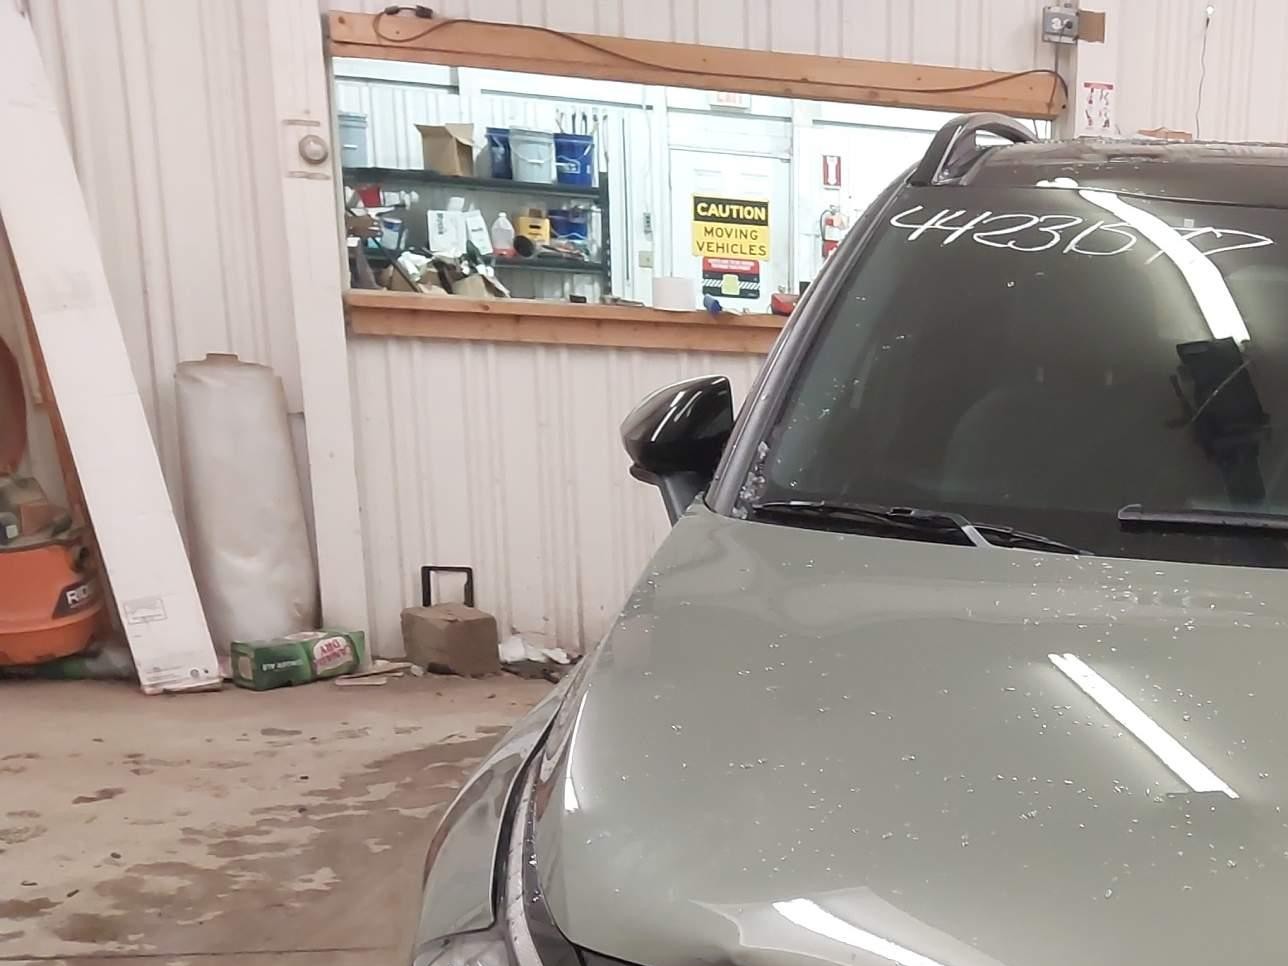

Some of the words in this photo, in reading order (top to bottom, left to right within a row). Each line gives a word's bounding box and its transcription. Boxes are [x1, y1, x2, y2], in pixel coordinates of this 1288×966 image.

[696, 202, 766, 220] CAUTION
[703, 226, 758, 241] MOVING
[696, 241, 767, 256] VEHICLES
